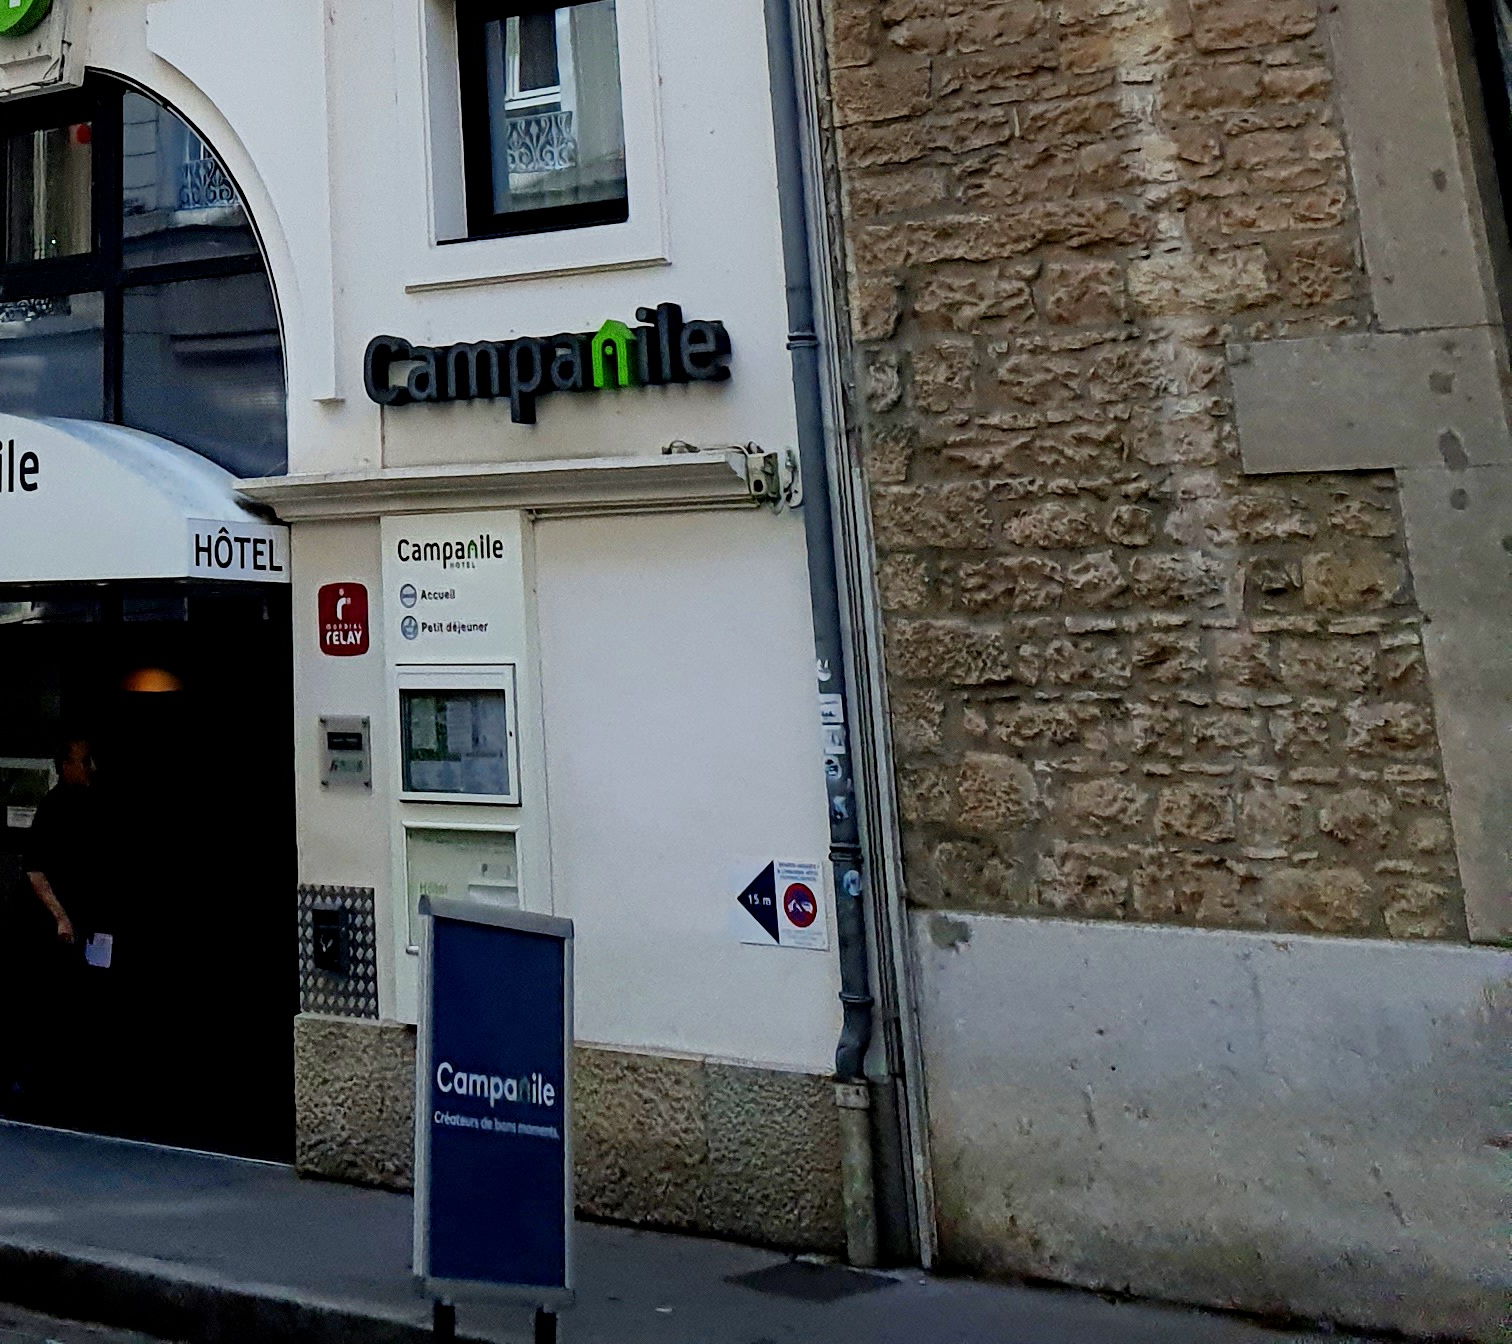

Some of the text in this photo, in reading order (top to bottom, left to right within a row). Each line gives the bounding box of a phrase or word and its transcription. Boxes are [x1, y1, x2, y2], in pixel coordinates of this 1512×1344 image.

[364, 302, 733, 425] Campanile
[195, 526, 284, 574] HÔTEL
[397, 534, 504, 569] Campanile
[449, 561, 476, 569] HOTEL
[420, 588, 456, 600] Accueil
[421, 621, 489, 635] Petit déjeuner
[748, 893, 760, 905] 15
[437, 1061, 556, 1109] Campanile
[434, 1110, 480, 1129] Créateurs
[480, 1116, 493, 1130] de
